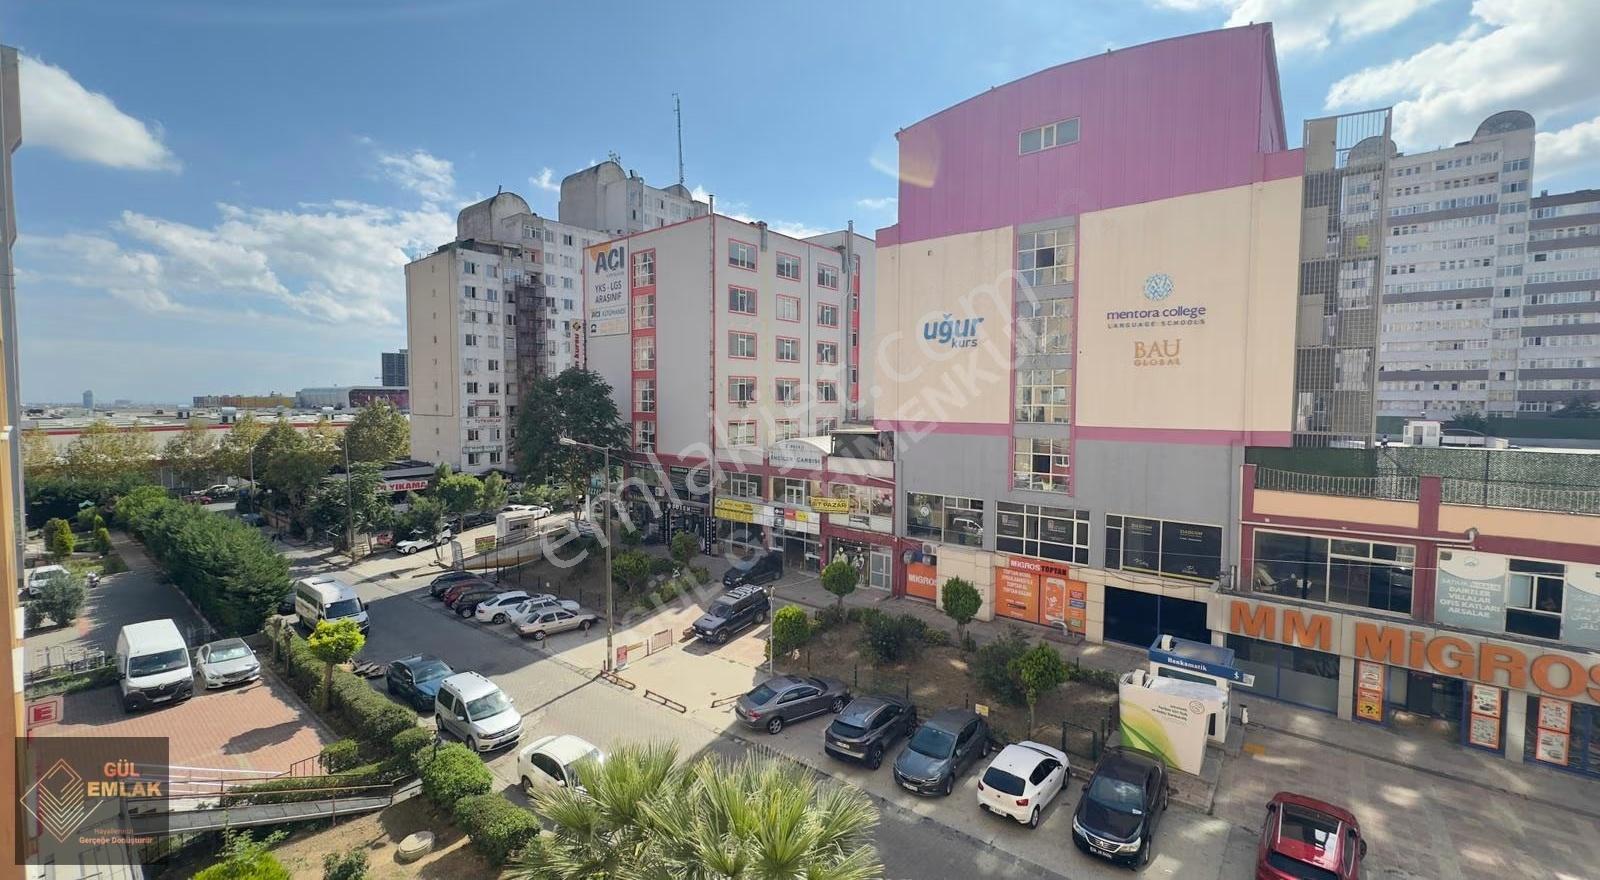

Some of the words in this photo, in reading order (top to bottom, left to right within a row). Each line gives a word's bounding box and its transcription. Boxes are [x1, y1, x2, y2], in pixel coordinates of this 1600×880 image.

[594, 284, 607, 294] YKS
[610, 280, 622, 291] LGS
[1106, 306, 1160, 320] mentora
[1162, 304, 1206, 320] college
[923, 313, 985, 343] uğur
[1107, 320, 1155, 329] LANGUAGE
[1160, 319, 1206, 327] SCHOOLS
[951, 337, 978, 349] kurs
[1134, 338, 1183, 359] BAU
[1134, 358, 1181, 367] GLOBAL
[1230, 600, 1332, 651] MM
[1167, 656, 1208, 672] Bankamatik
